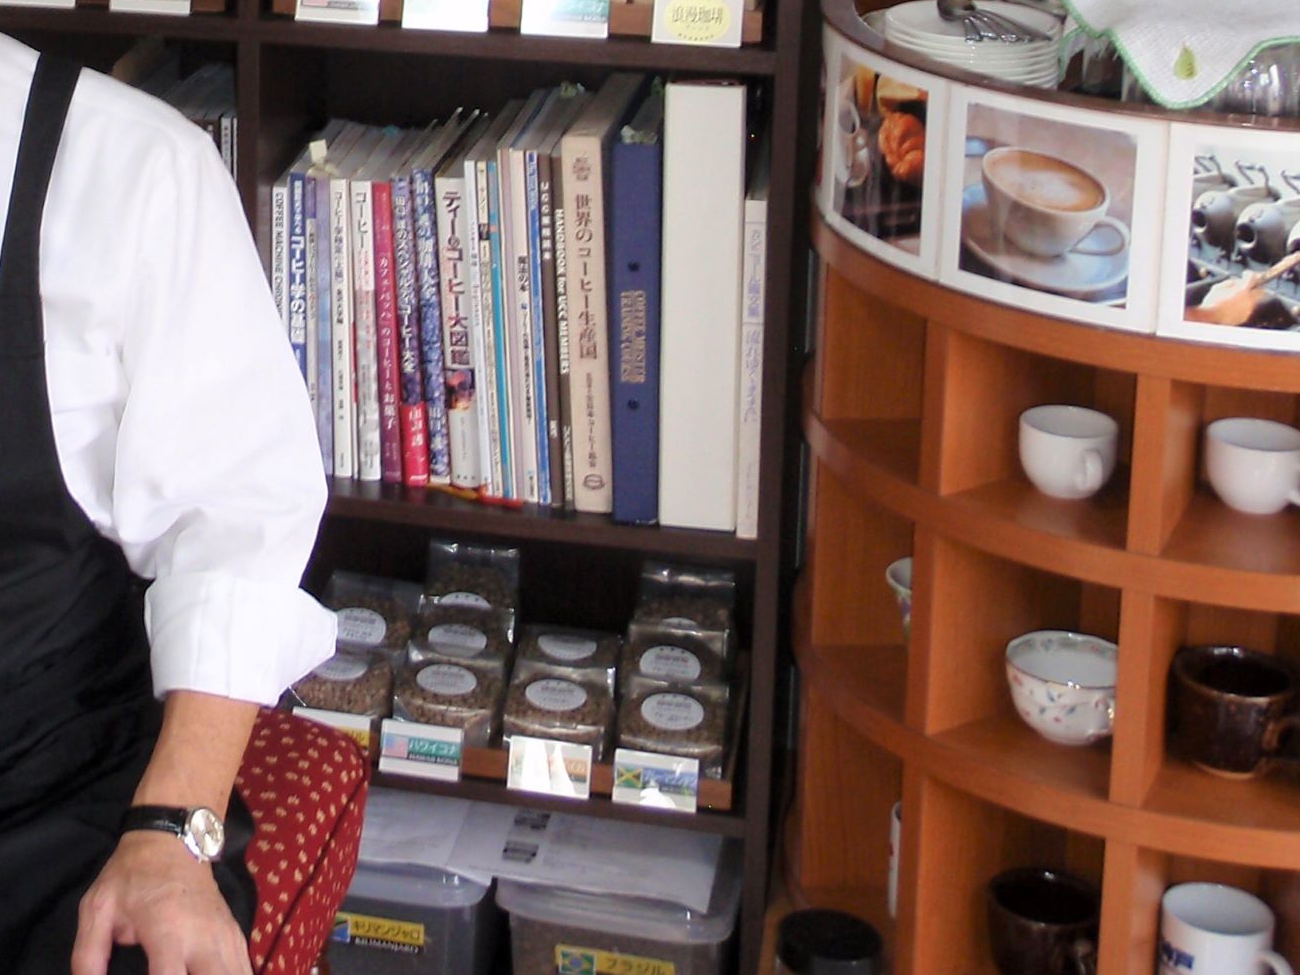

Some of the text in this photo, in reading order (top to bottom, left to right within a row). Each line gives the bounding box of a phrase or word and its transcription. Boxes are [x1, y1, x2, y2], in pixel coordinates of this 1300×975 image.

[275, 192, 284, 228] COFFEE
[355, 191, 369, 249] コーヒー
[275, 230, 284, 274] MACHINE
[555, 208, 566, 274] HANDBOOK
[574, 193, 598, 360] 世界のコーヒー生産国
[354, 920, 421, 940] キリマンジャロ
